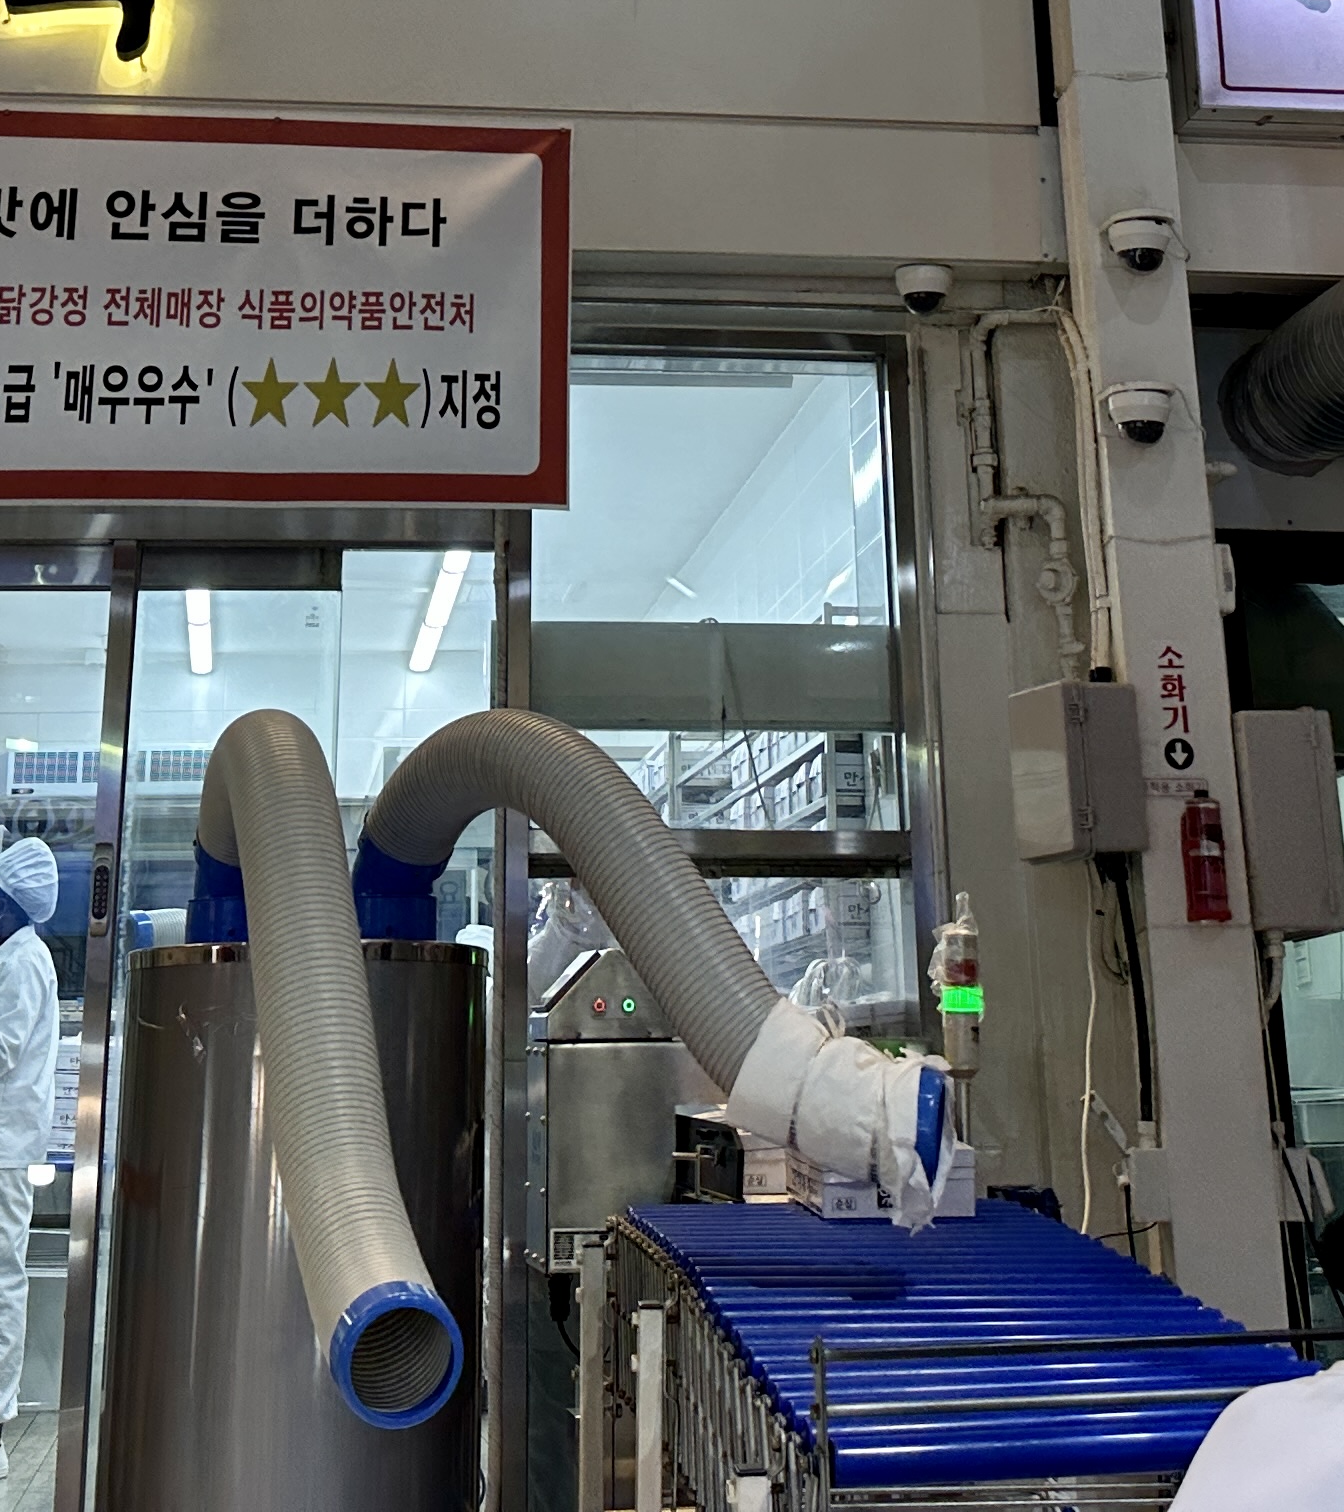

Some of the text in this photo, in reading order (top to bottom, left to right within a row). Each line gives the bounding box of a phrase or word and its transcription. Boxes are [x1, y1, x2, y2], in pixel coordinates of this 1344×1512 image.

[106, 189, 265, 244] 안심을
[292, 193, 447, 248] 더하다
[103, 286, 226, 329] 전체매장
[237, 288, 475, 334] 식품의약품안전처
[54, 360, 214, 426] '매우우수'
[1157, 644, 1190, 734] 소화기
